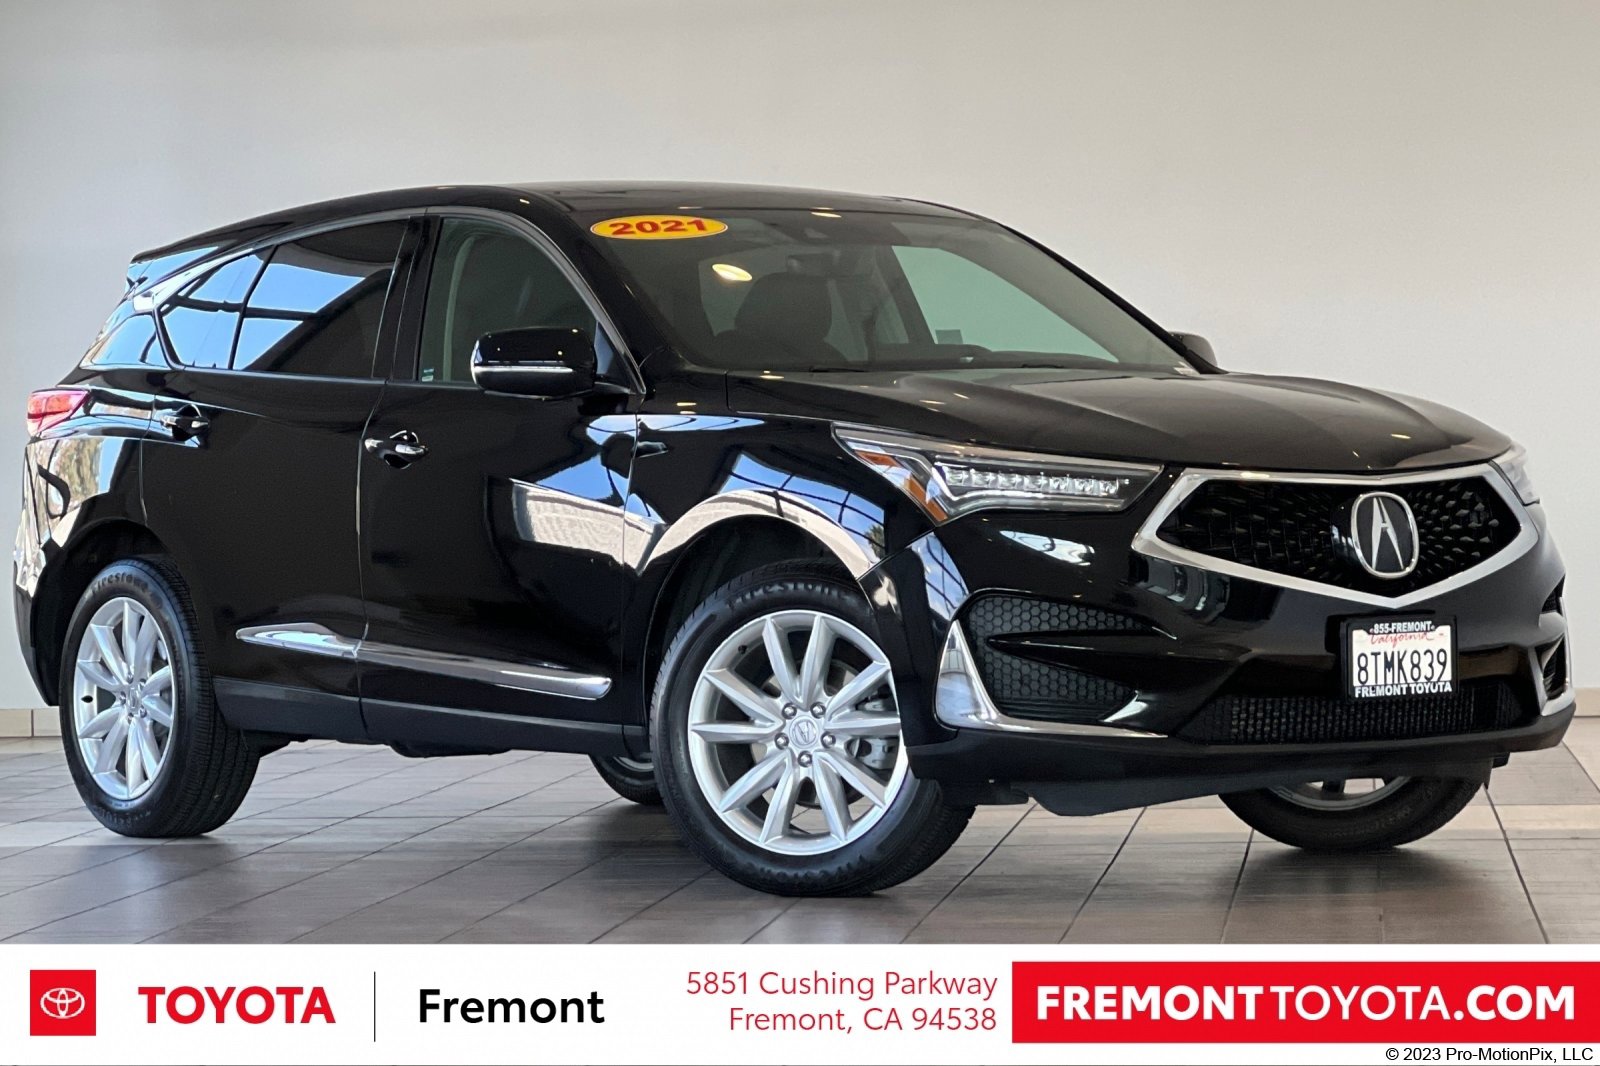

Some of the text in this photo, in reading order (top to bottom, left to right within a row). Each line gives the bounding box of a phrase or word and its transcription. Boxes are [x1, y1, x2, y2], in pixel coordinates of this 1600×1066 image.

[609, 219, 707, 236] 2021
[1373, 620, 1432, 634] 855-FREMONT
[1357, 648, 1447, 686] 8TMK839
[1355, 681, 1453, 698] FREMONT TOYOTA
